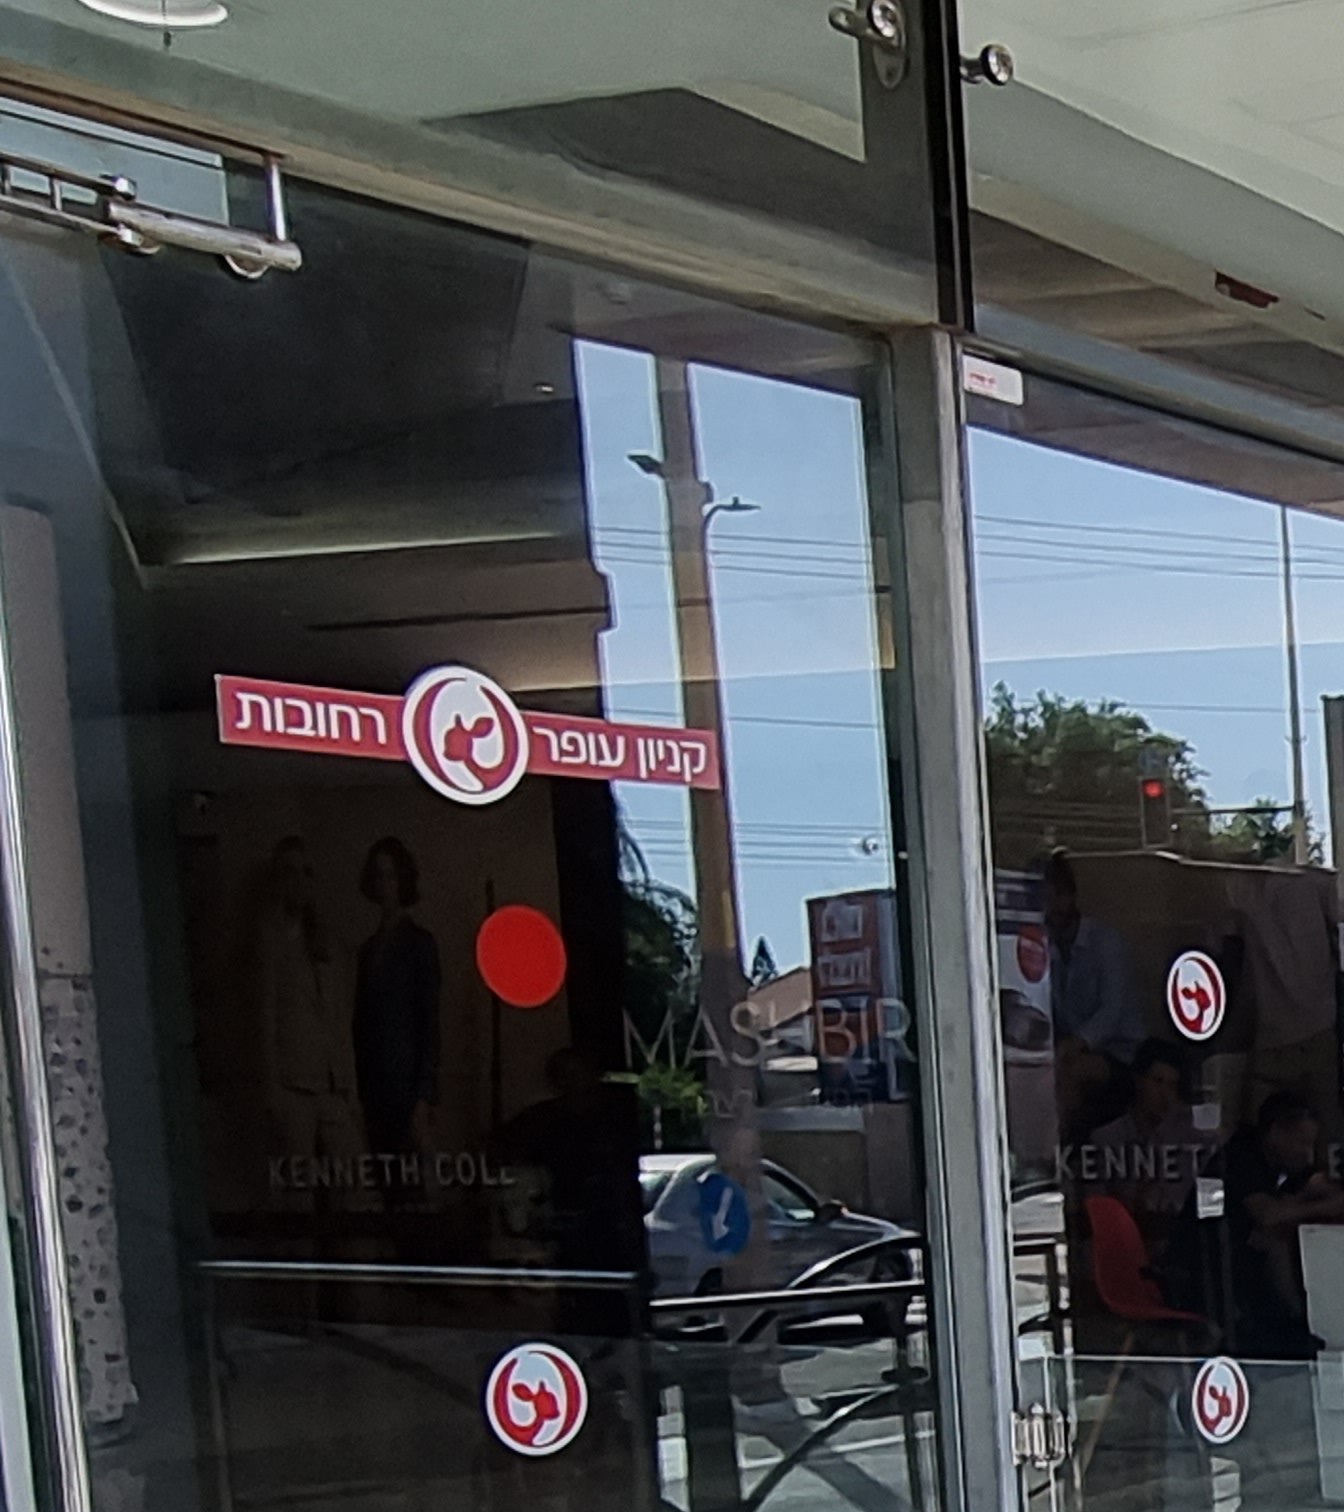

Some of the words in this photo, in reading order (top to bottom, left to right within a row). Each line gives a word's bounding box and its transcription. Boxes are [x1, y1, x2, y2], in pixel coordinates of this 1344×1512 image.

[234, 689, 389, 748] רחובות
[532, 724, 625, 774] עופר
[636, 736, 707, 783] קניון
[267, 1152, 421, 1189] KENNETH
[1053, 1141, 1221, 1183] KENNET
